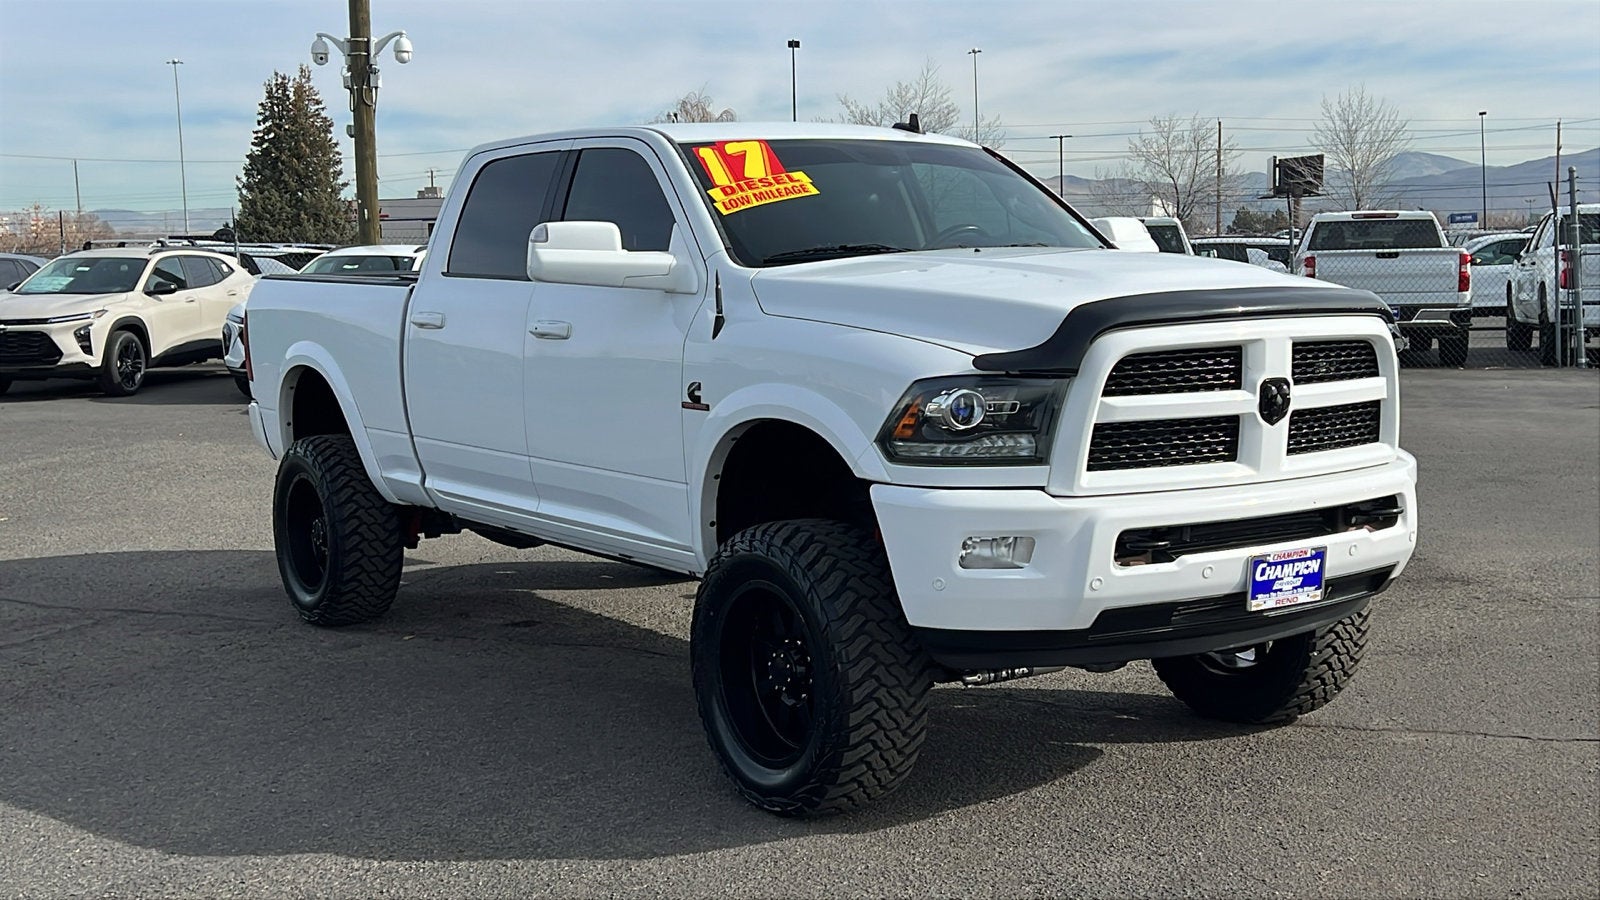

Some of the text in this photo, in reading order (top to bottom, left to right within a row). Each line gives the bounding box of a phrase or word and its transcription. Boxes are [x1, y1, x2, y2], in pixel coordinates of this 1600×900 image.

[699, 141, 771, 186] 17
[720, 174, 800, 196] DIESEL
[722, 184, 809, 211] LOW MILEAGE
[1273, 550, 1308, 560] CHAMPION
[1255, 559, 1321, 581] CHAMPION
[1275, 597, 1298, 605] RENO
